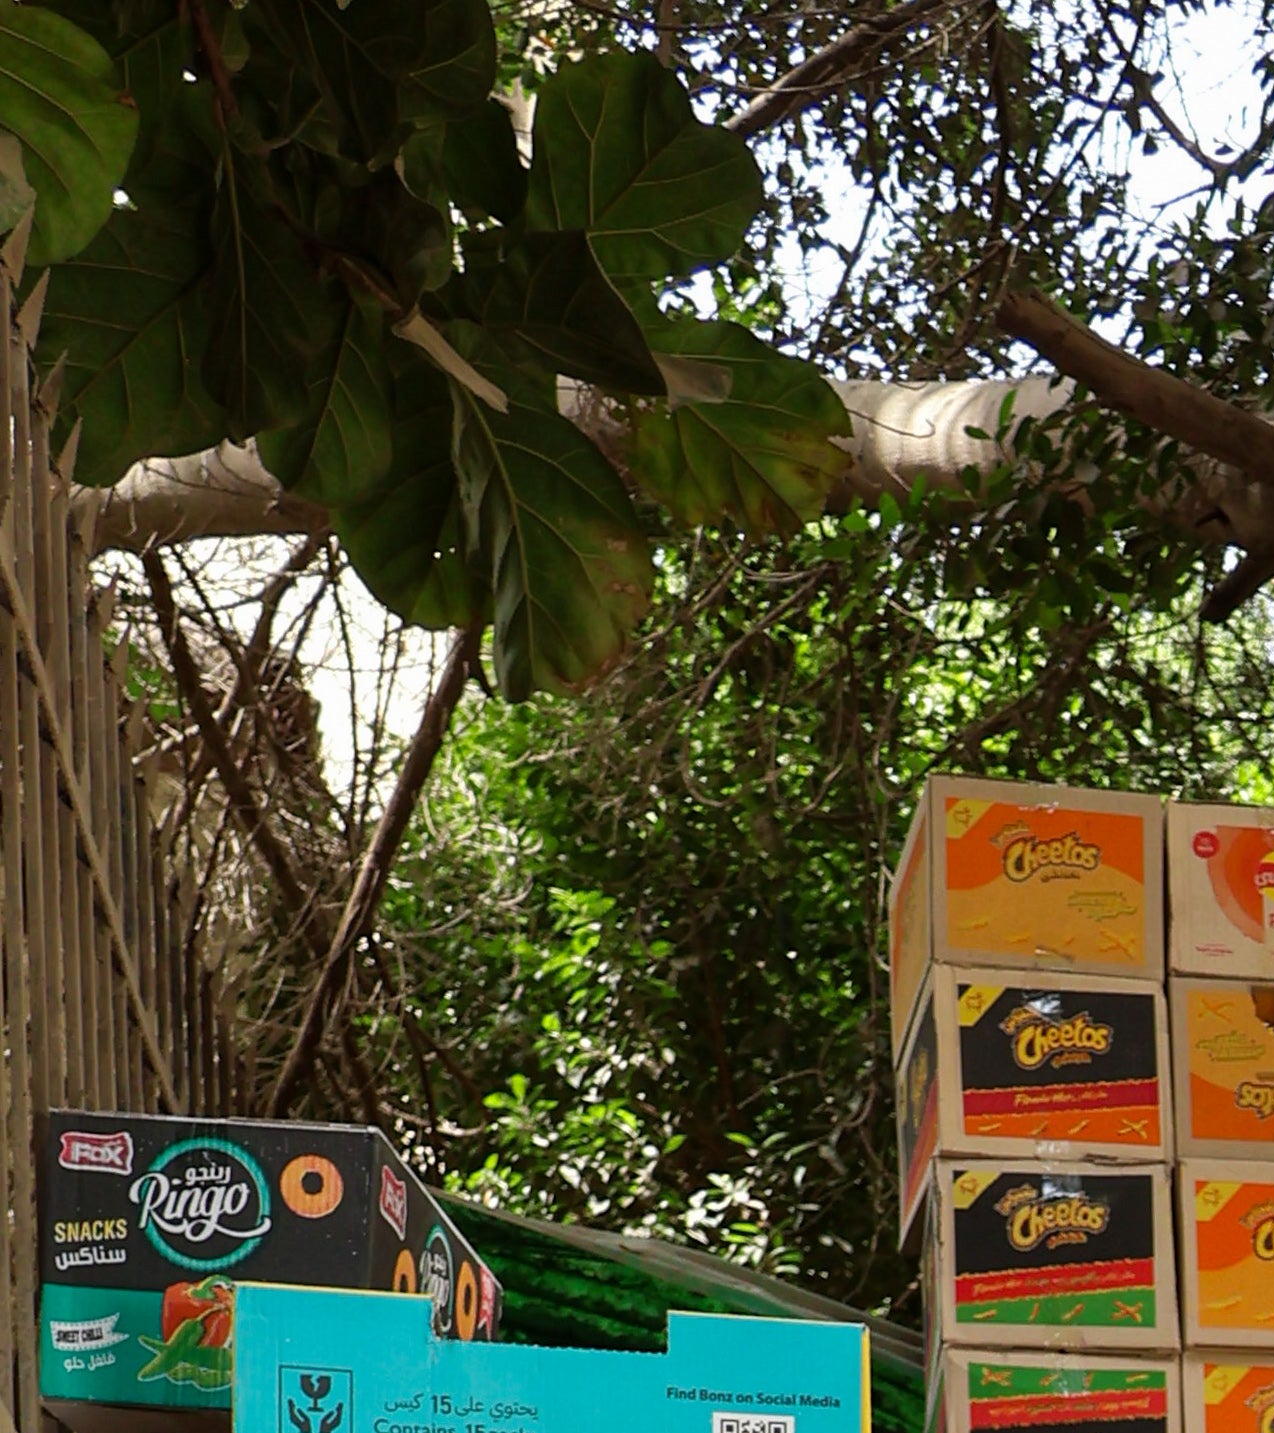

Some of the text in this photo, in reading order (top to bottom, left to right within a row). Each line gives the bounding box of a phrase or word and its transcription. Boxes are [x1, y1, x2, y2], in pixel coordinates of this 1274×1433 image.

[1004, 832, 1100, 882] Cheetos
[1014, 1011, 1113, 1069] Cheetos
[129, 1171, 272, 1242] Ringo
[54, 1220, 128, 1244] SNACKS
[55, 1247, 127, 1271] سناكس
[430, 1394, 452, 1416] 15
[666, 1387, 840, 1408] Find Bonz on Social Media
